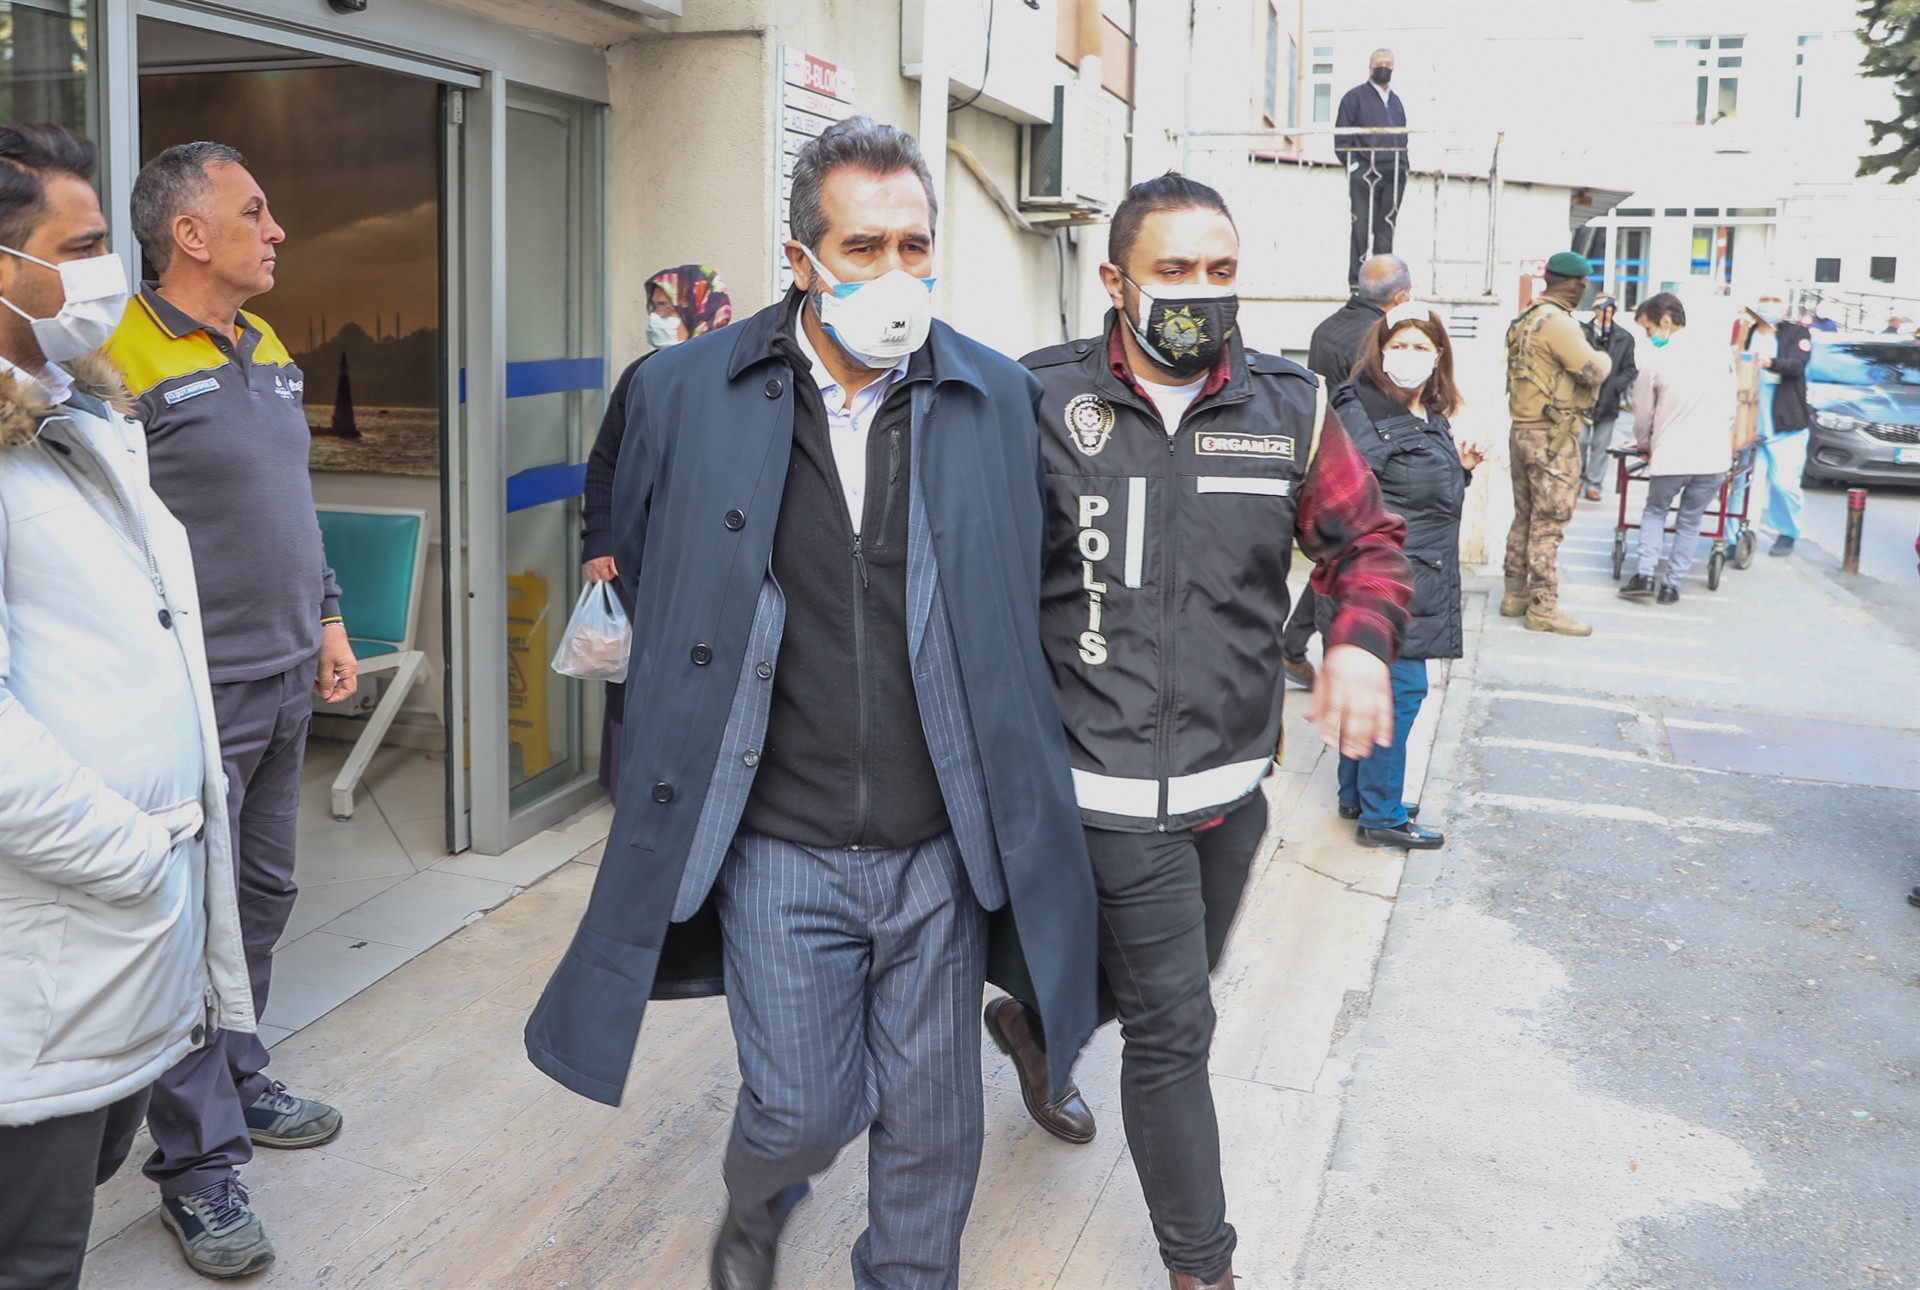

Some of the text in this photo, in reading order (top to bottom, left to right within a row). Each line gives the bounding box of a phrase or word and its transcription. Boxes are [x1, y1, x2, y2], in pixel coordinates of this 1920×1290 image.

[804, 61, 838, 93] B-BLOK
[891, 321, 905, 329] 3M
[1201, 436, 1291, 455] ORGANİZE
[1078, 494, 1110, 666] POLİS
